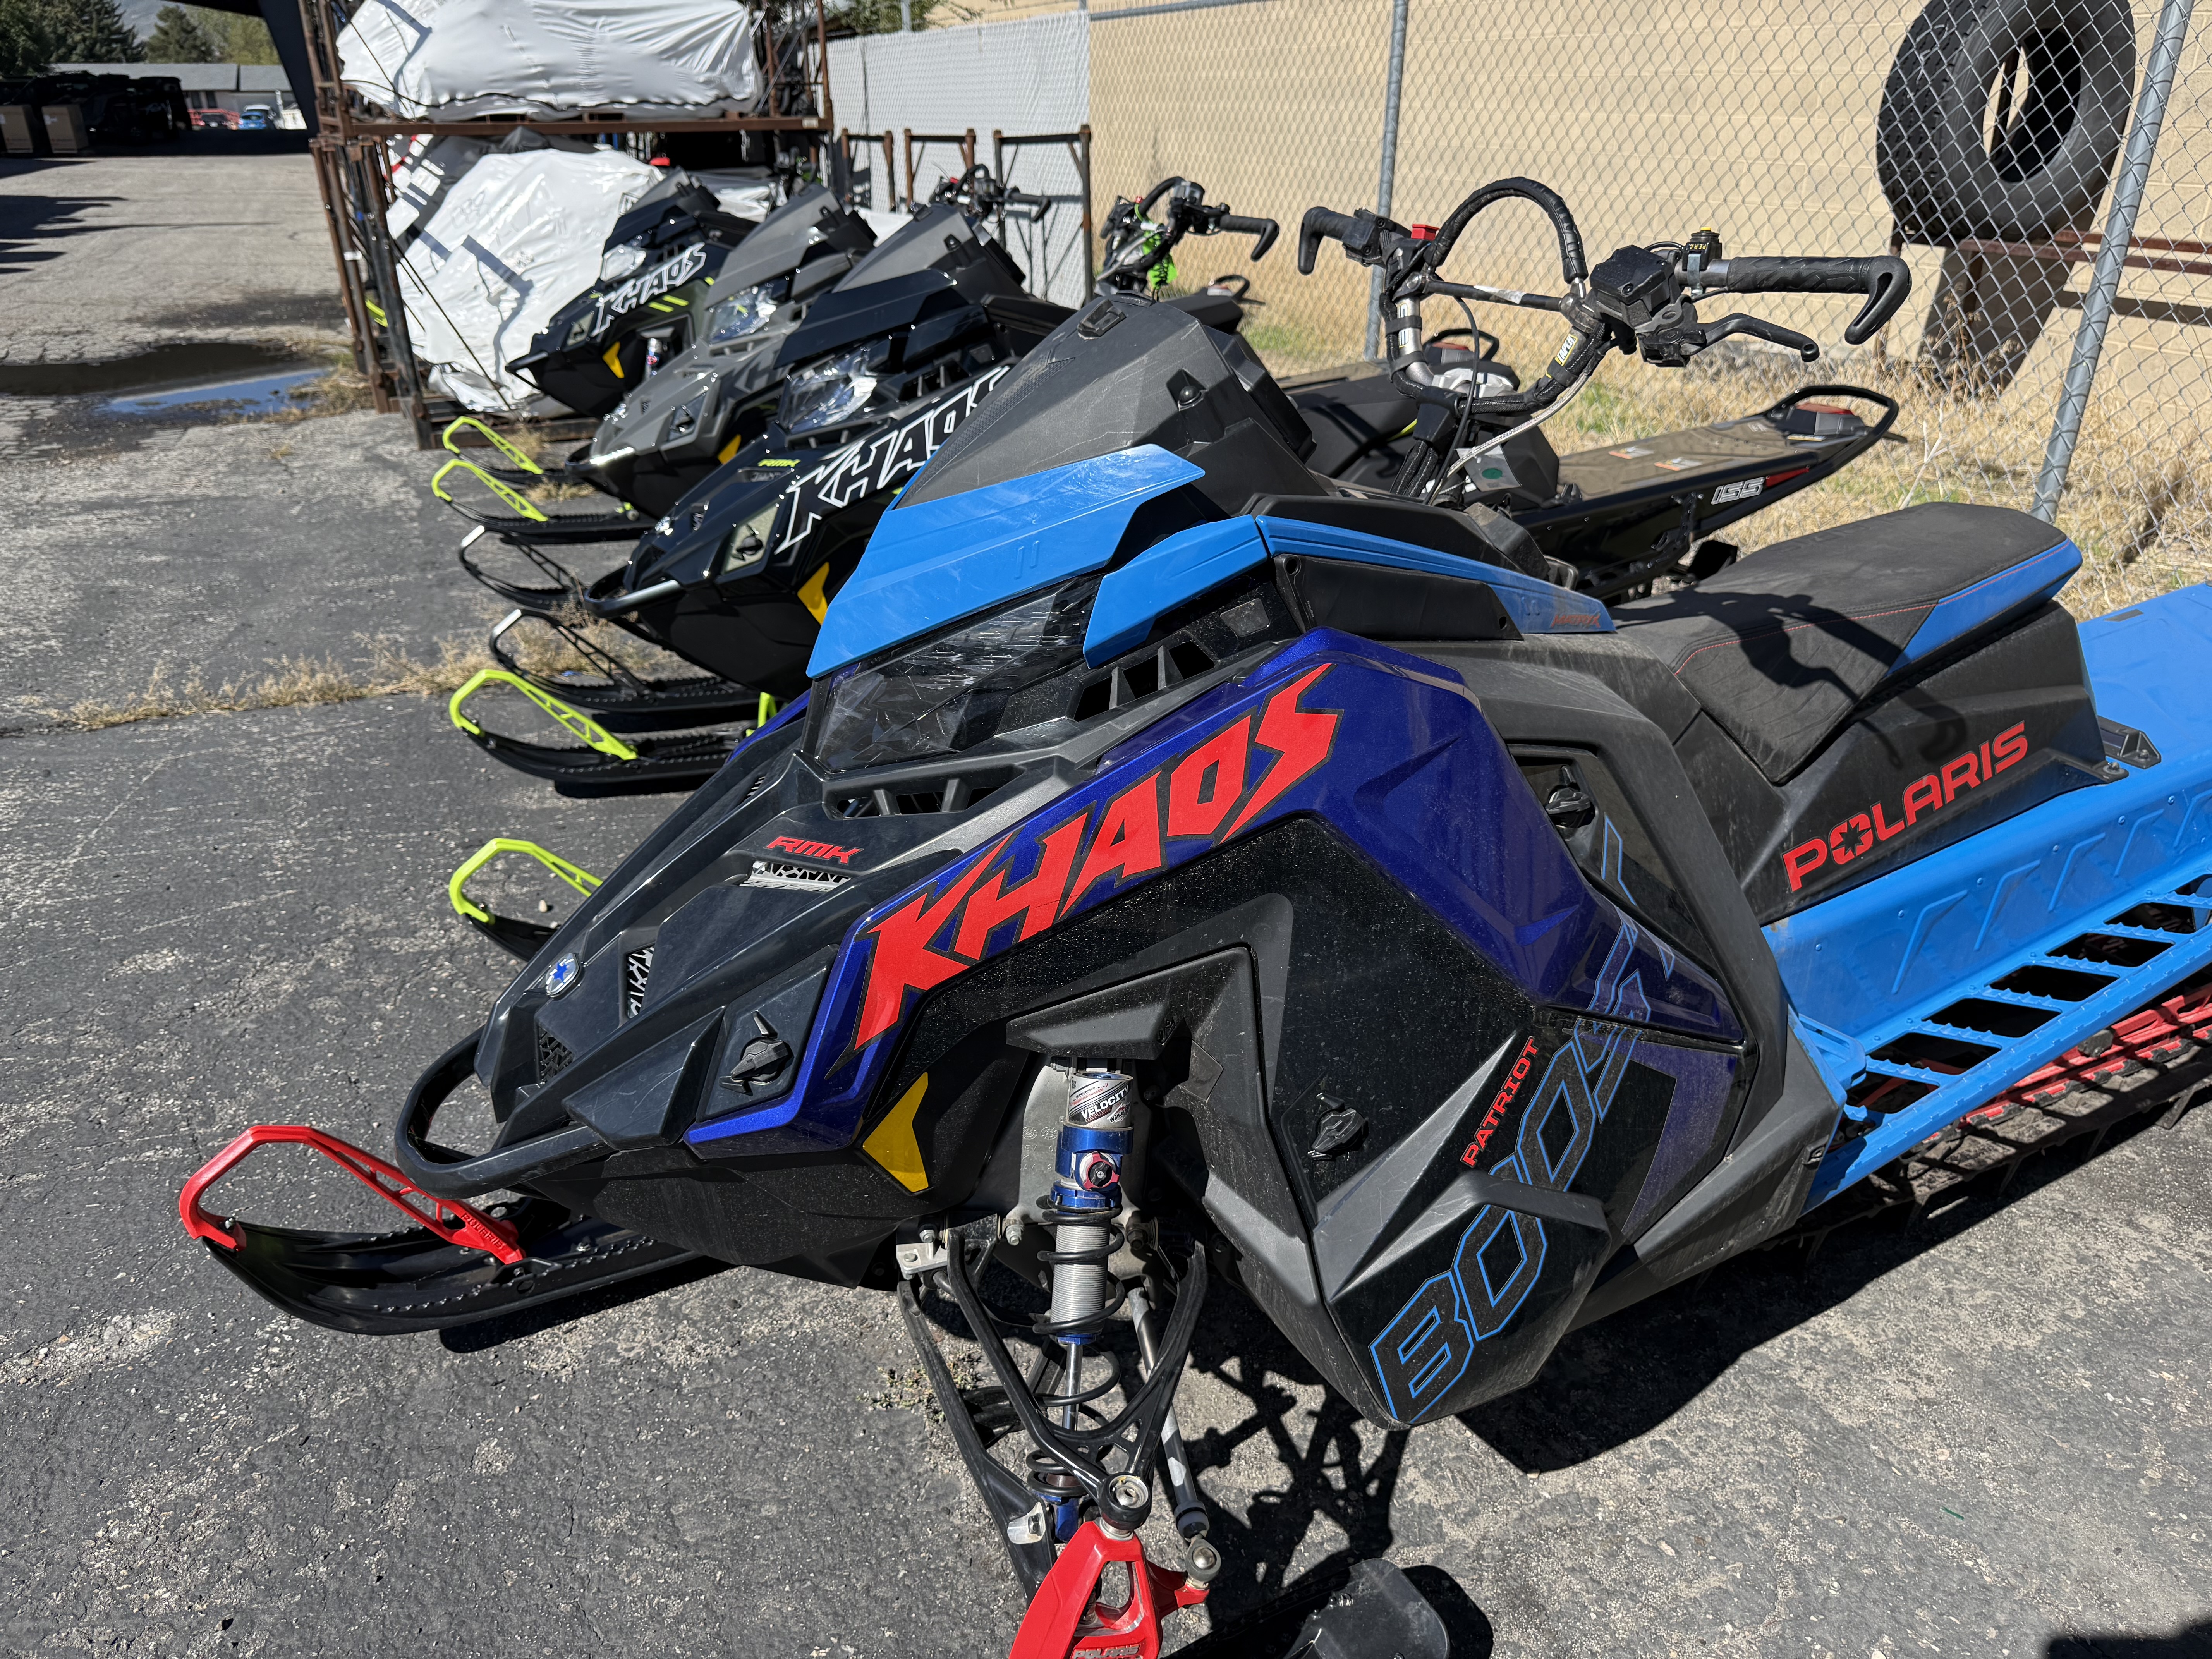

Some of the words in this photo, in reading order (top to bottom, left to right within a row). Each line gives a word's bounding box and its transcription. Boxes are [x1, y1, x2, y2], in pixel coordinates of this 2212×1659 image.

[590, 242, 707, 337] KHAOS
[1711, 477, 1765, 505] 155
[1783, 720, 2028, 892] POLARIS
[764, 835, 862, 864] RMK
[852, 661, 1341, 1052] KHAOS
[1081, 1084, 1128, 1118] VELOCITY
[1085, 1108, 1111, 1122] SERIES
[1462, 1038, 1537, 1166] PATRIOT
[461, 1212, 504, 1249] POLARIS
